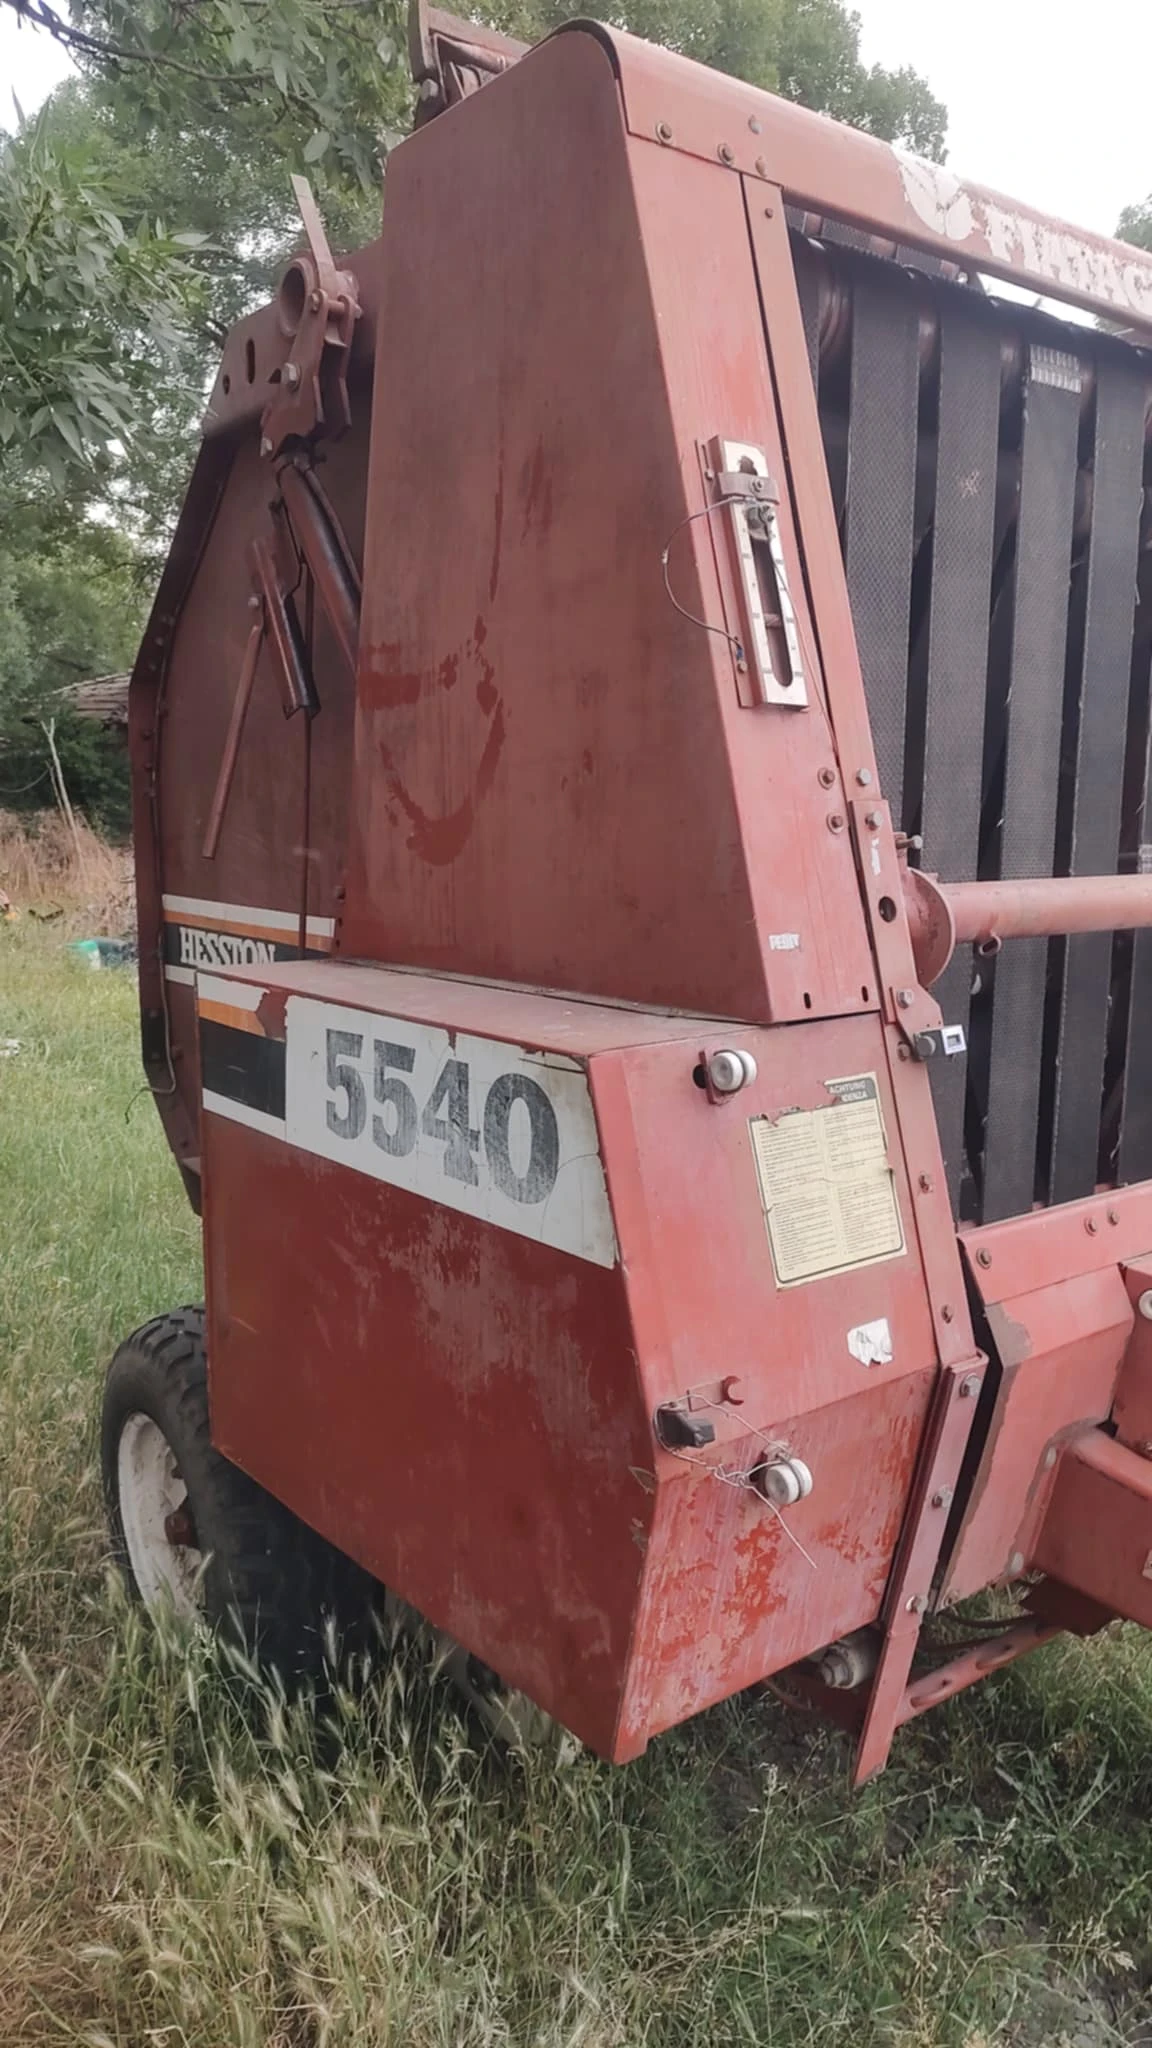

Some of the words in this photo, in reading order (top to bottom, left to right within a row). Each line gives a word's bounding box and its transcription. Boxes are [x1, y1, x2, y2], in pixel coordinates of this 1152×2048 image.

[180, 926, 276, 966] HESSTON
[326, 1028, 560, 1204] 5540
[841, 1091, 869, 1102] DENZA
